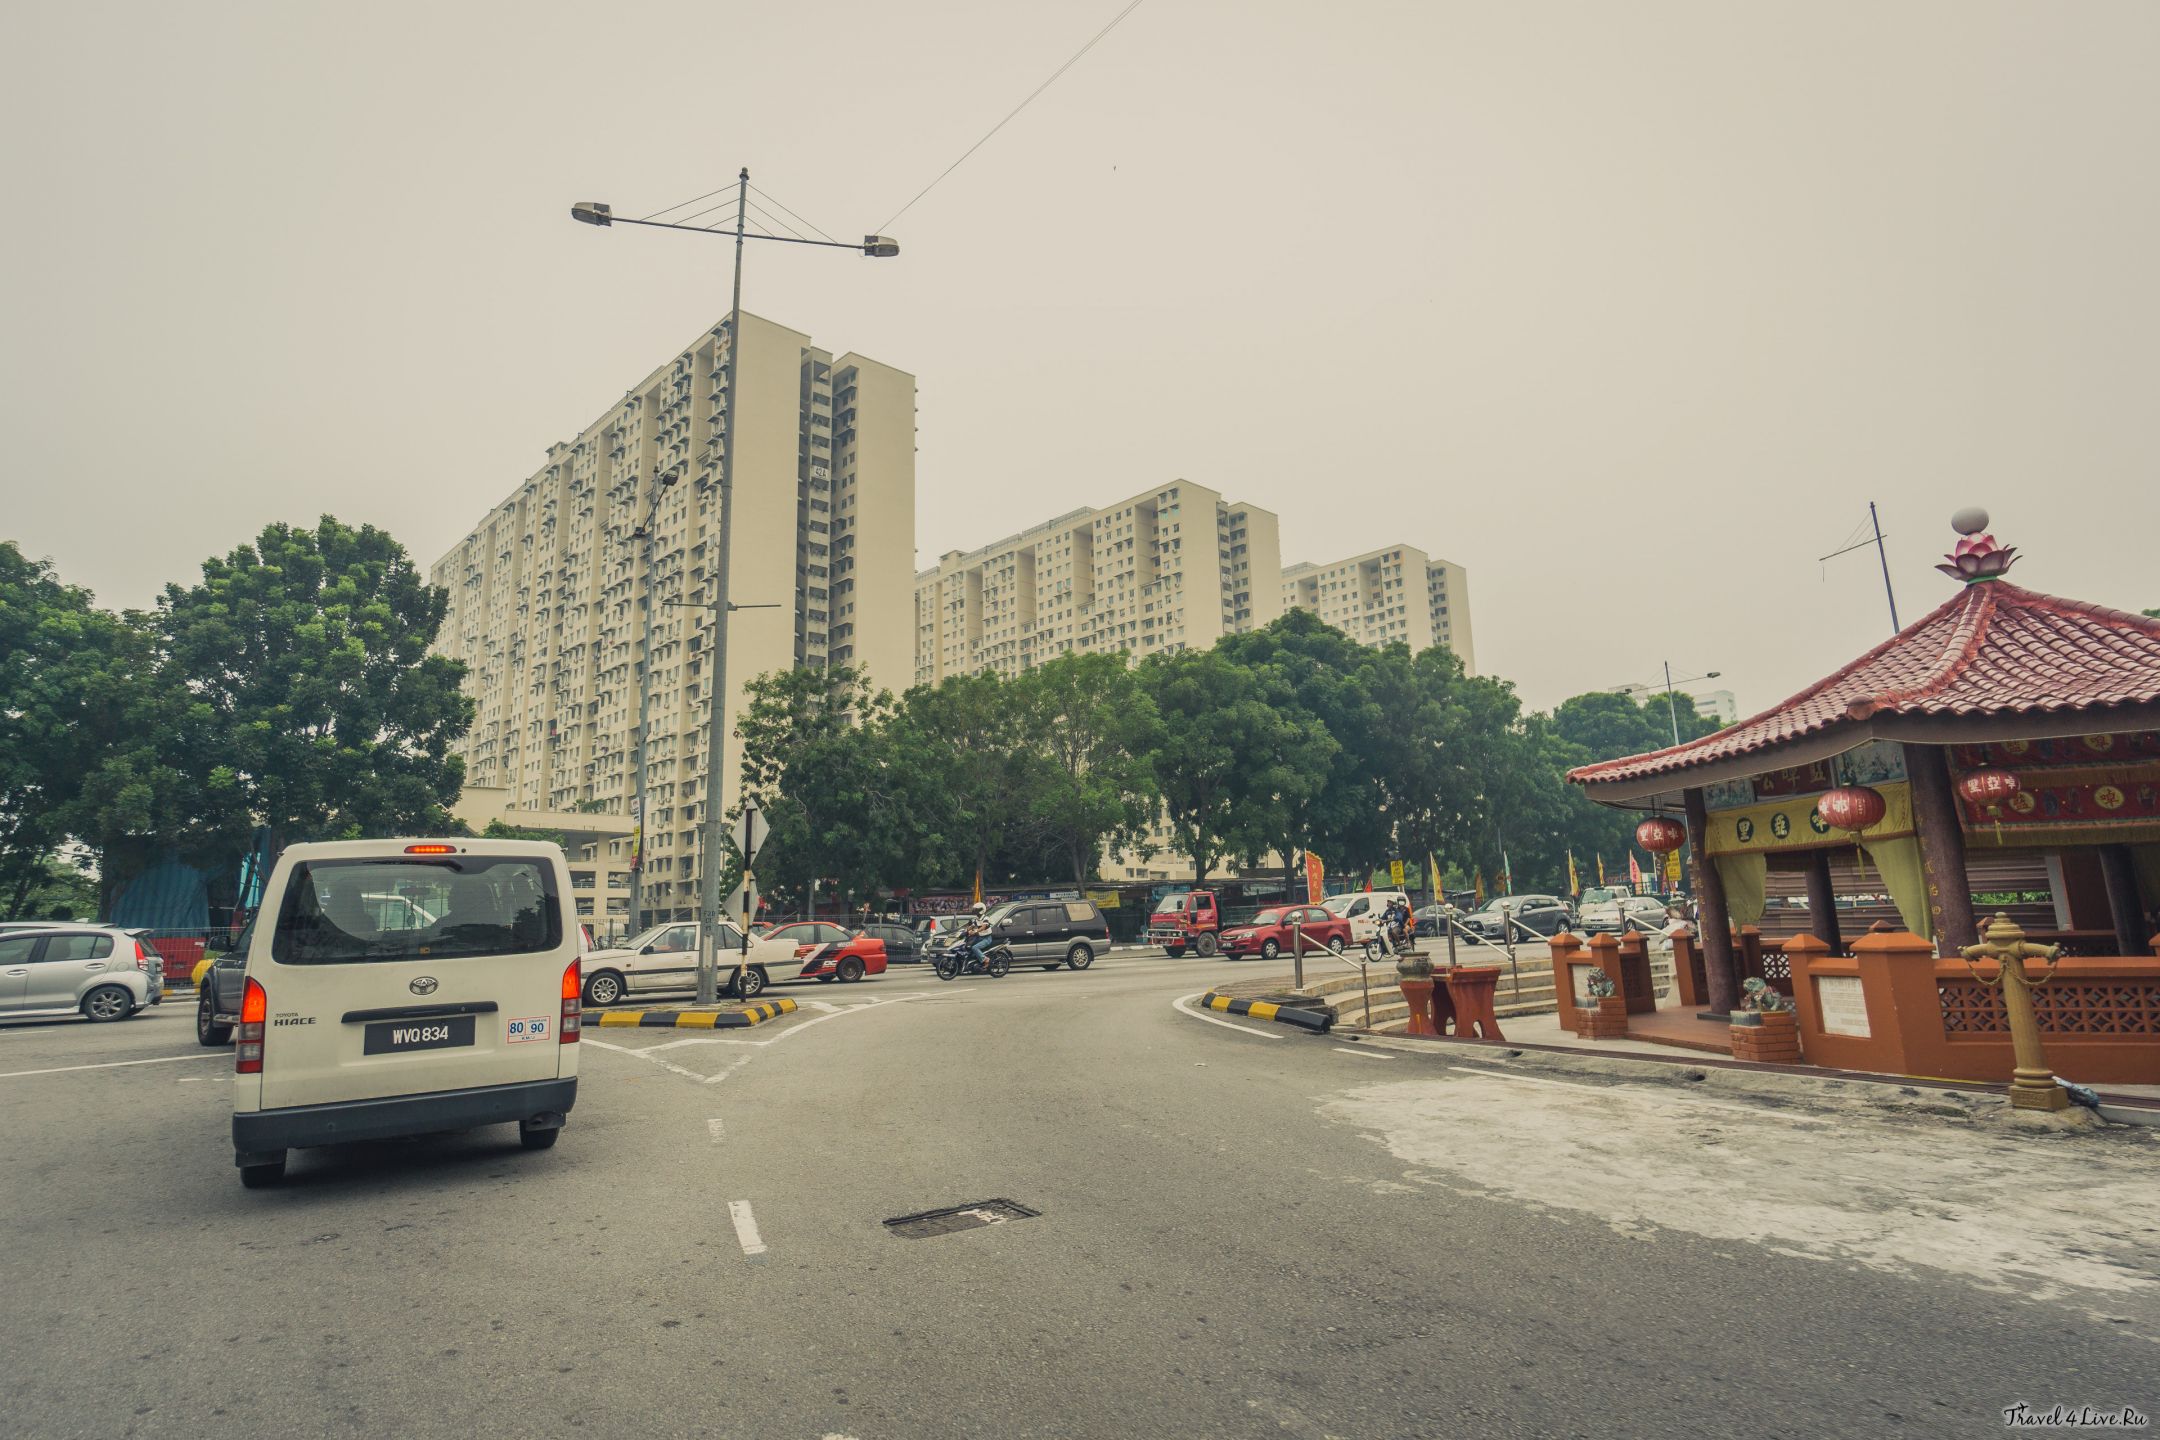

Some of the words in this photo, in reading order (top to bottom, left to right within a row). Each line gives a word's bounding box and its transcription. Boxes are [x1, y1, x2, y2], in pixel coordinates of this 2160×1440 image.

[274, 1017, 316, 1026] HIACE
[510, 1022, 524, 1033] 80
[530, 1022, 544, 1033] 90
